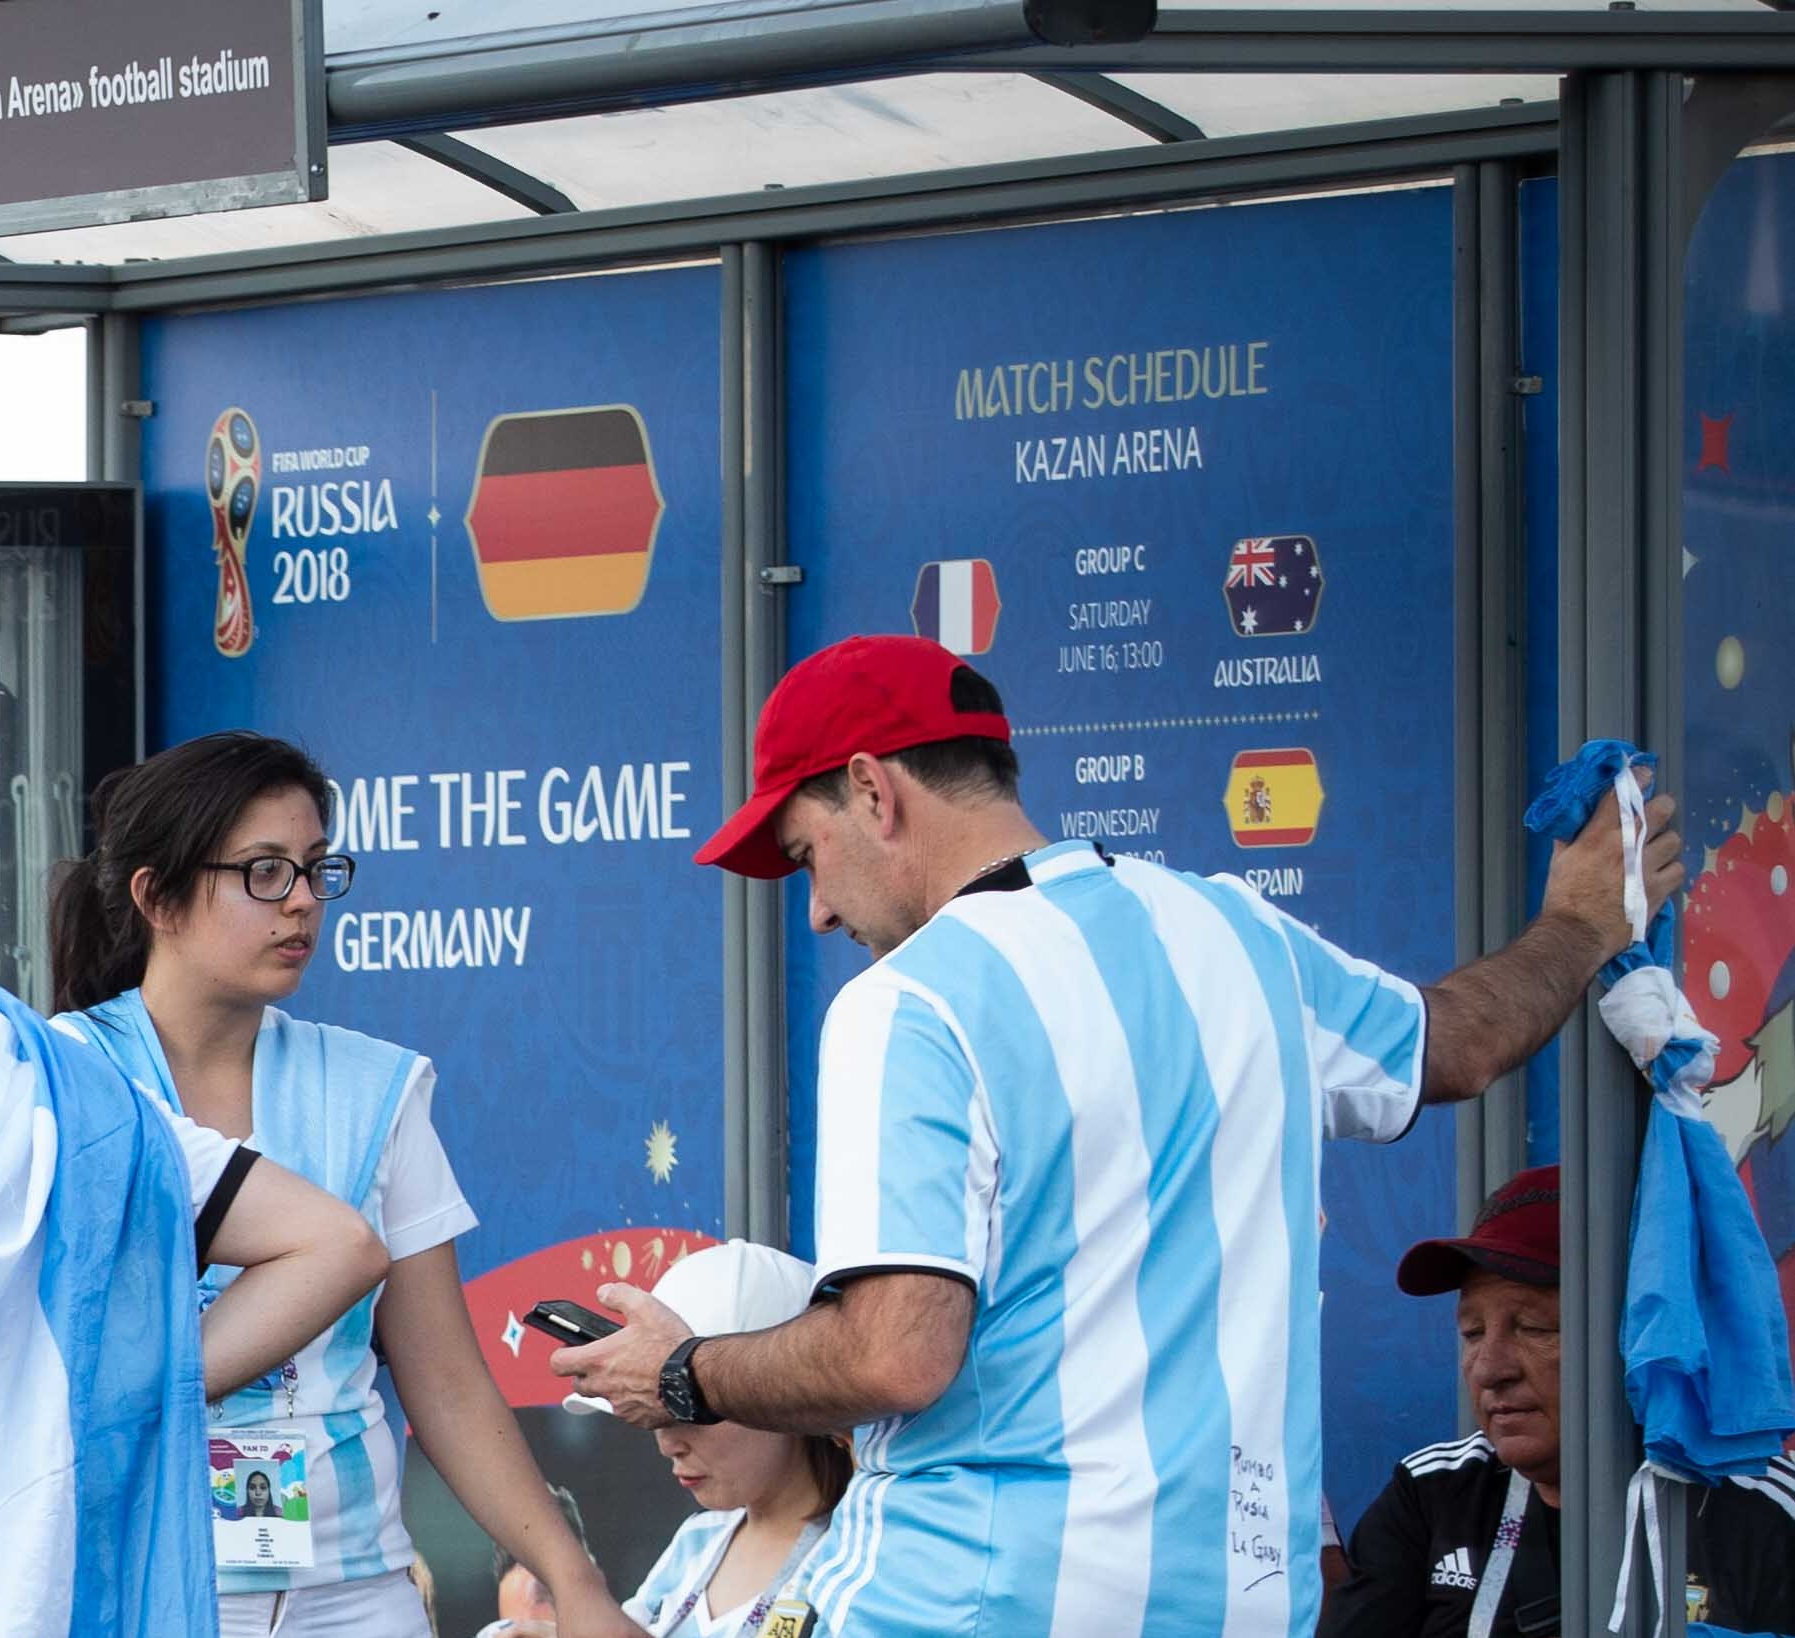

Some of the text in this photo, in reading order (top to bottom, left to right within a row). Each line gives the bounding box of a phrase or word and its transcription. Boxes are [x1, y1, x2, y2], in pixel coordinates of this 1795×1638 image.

[7, 76, 84, 119] Arena»
[88, 56, 173, 108] football
[178, 49, 270, 98] stadium
[955, 341, 1269, 421] MATCH SCHEDULE
[272, 445, 371, 473] FIFA WORLD CUP
[1016, 426, 1203, 483] KAZAN ARENA
[272, 478, 398, 538] RUSSIA
[272, 547, 351, 604] 2018
[1075, 544, 1145, 576] GROUP C
[1069, 599, 1151, 631] SATURDAY
[1057, 640, 1163, 673] JUNE 16; 13:00
[1213, 654, 1321, 688] AUSTRALIA
[1075, 754, 1145, 784] GROUP B
[429, 769, 527, 849] THE
[538, 761, 691, 845] GAME
[1060, 808, 1160, 838] WEDNESDAY
[1245, 866, 1304, 898] SPAIN
[334, 906, 531, 972] GERMANY
